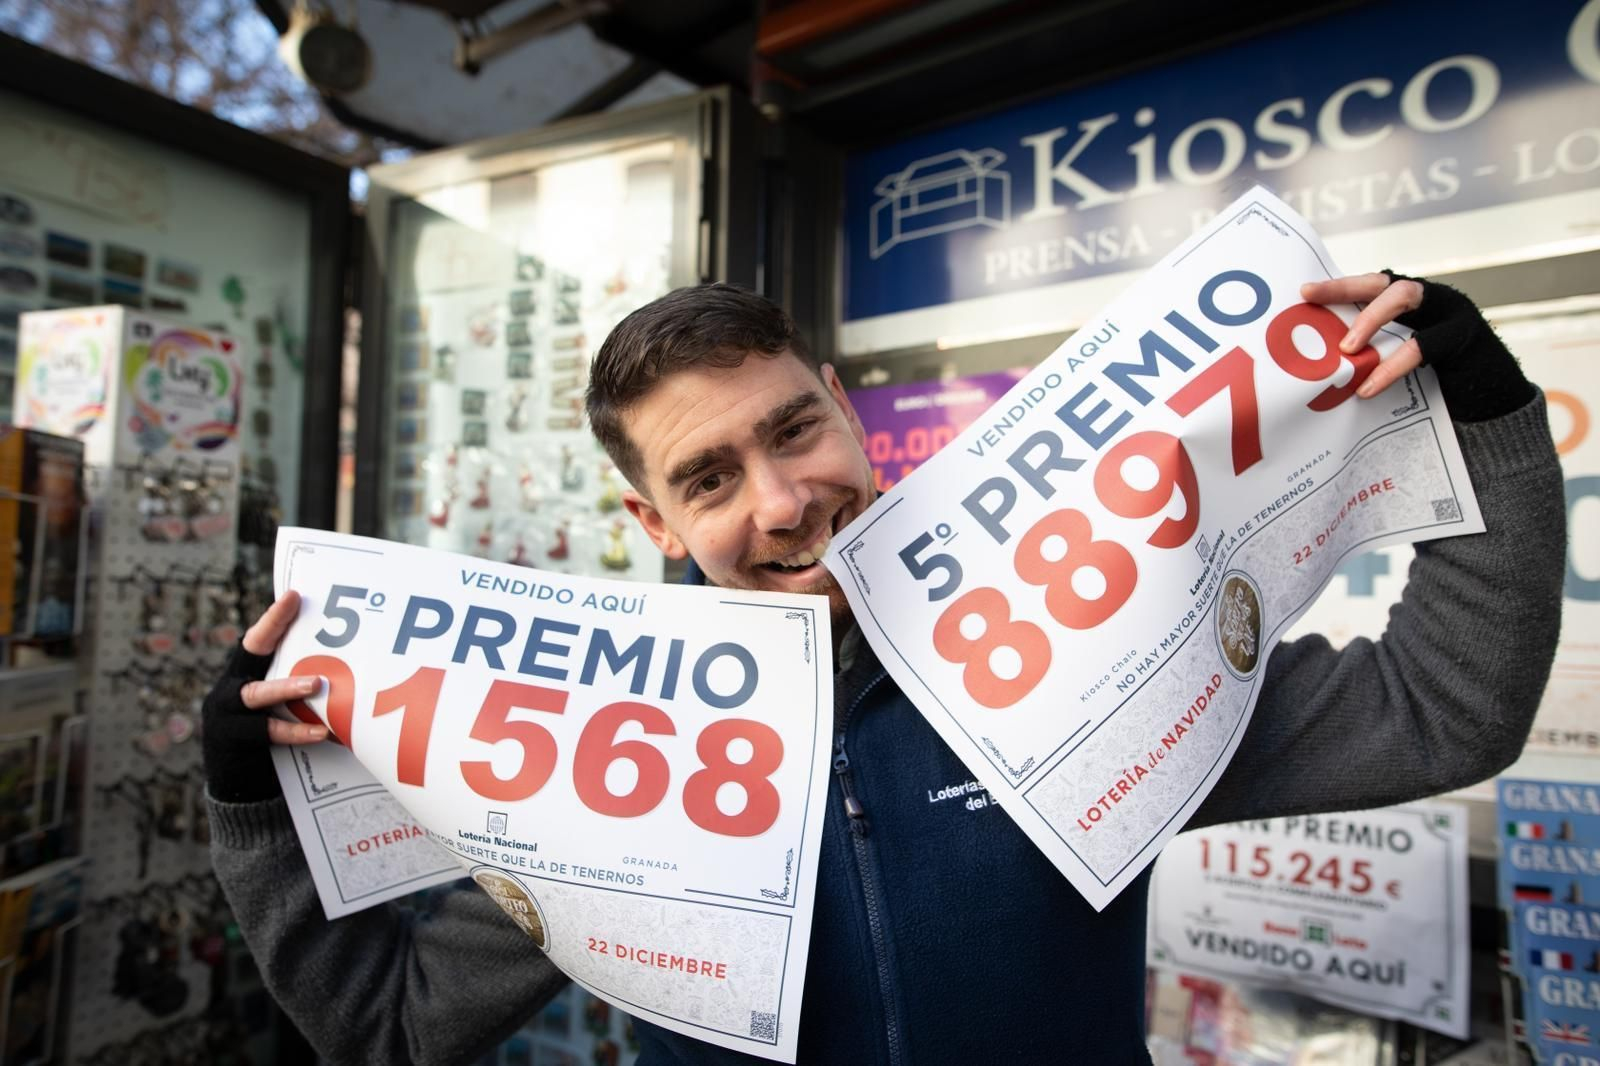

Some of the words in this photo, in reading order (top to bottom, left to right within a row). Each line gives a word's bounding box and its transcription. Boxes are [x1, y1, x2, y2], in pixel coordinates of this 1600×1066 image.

[1021, 54, 1500, 223] Kiosco
[985, 223, 1150, 284] PRENSA
[1190, 157, 1461, 236] ISTAS
[960, 270, 1272, 546] PREMIO
[967, 373, 1062, 458] VENDIDO
[1067, 319, 1121, 373] AQUÍ
[1287, 449, 1332, 483] GRANADA
[933, 302, 1380, 709] 88979
[1292, 545, 1313, 565] 22
[1315, 477, 1396, 547] DICIEMBRE
[461, 569, 574, 604] VENDIDO
[581, 593, 648, 616] AQUÍ
[1116, 673, 1136, 693] NO
[1136, 648, 1161, 676] HAY
[1160, 610, 1197, 652] MAYOR
[1196, 571, 1219, 612] SUERTE
[1217, 549, 1228, 572] QUE
[1224, 535, 1238, 551] LA
[1237, 521, 1253, 538] DE
[1253, 477, 1315, 524] TENERNOS
[392, 595, 759, 709] PREMIO
[1079, 674, 1111, 703] Kiosco
[1077, 764, 1149, 832] LOTERÍA
[1147, 747, 1166, 769] de
[1160, 673, 1222, 751] NAVIDAD
[965, 794, 988, 811] del
[346, 823, 424, 857] LOTERÍA
[494, 837, 538, 853] Nacional
[1285, 816, 1413, 853] PREMIO
[456, 839, 498, 861] SUERTE
[500, 853, 527, 867] QUE
[530, 857, 546, 871] LA
[550, 861, 568, 875] DE
[571, 865, 645, 887] TENERNOS
[622, 856, 679, 872] GRANADA
[1199, 838, 1374, 895] 115.245
[1384, 880, 1402, 898] €
[588, 938, 608, 955] 22
[616, 944, 728, 980] DICIEMBRE
[1185, 928, 1314, 971] VENDIDO
